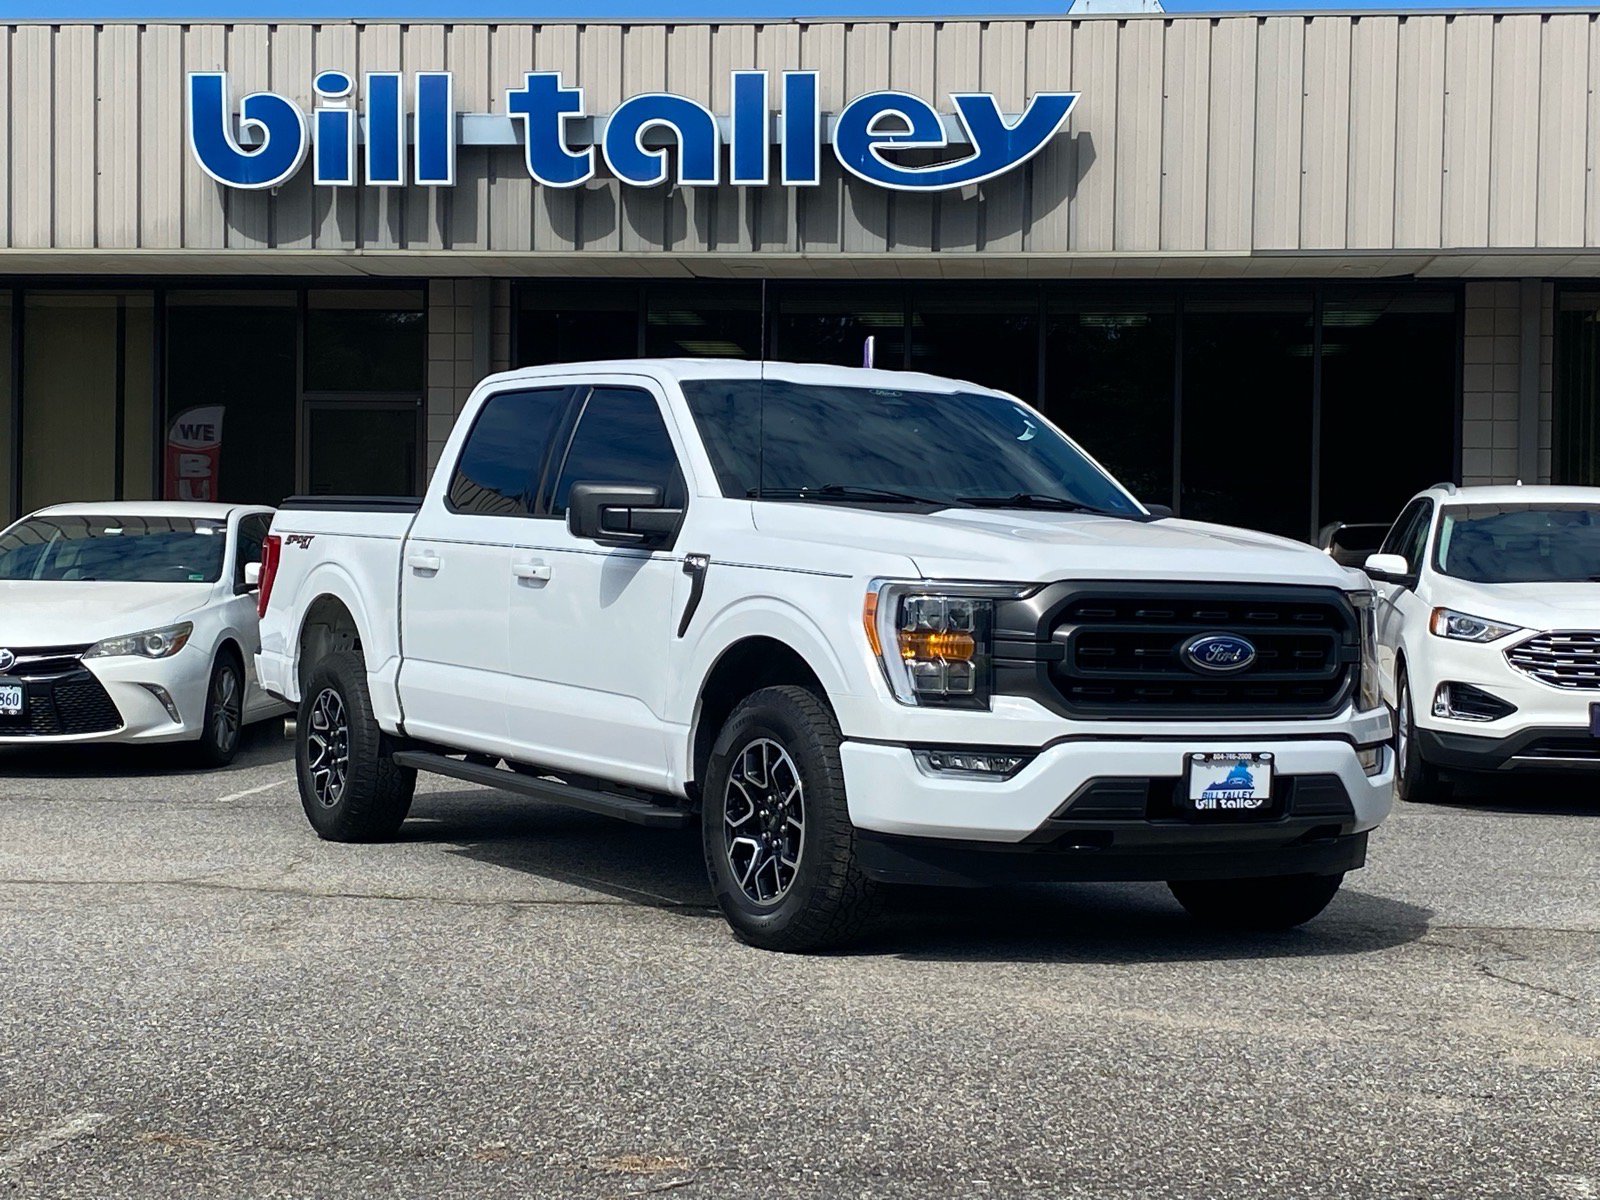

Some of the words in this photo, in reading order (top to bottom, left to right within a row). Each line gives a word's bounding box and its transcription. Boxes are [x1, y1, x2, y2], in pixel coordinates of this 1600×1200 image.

[188, 71, 456, 189] bill
[506, 70, 1081, 192] talley
[180, 423, 215, 441] WE
[1206, 642, 1242, 662] Ford
[1201, 790, 1219, 799] BILL
[1221, 790, 1254, 799] TALLEY
[1195, 798, 1217, 810] bill
[1220, 798, 1263, 809] talley
